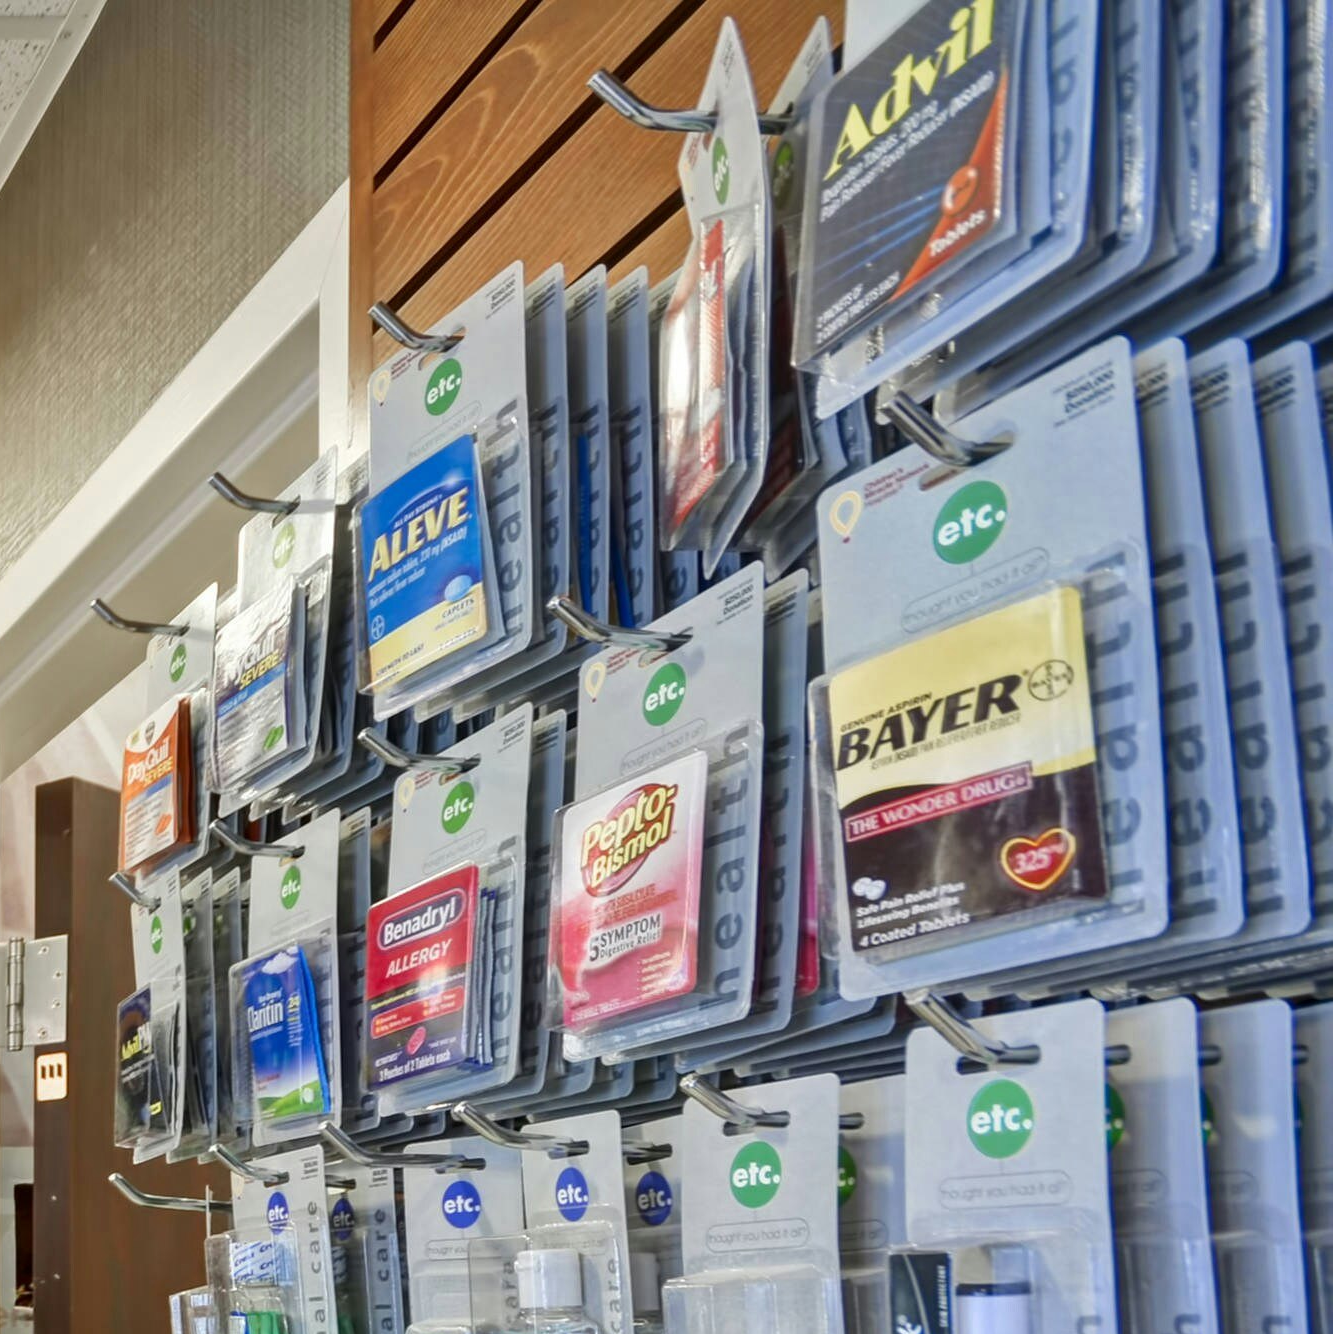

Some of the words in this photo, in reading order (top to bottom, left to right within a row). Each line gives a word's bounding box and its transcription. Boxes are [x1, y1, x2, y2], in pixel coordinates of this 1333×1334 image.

[823, 0, 993, 181] Advil
[930, 210, 986, 258] Tablets
[426, 373, 462, 405] etc.
[368, 487, 469, 583] ALEVE
[937, 504, 1007, 547] etc.
[240, 650, 281, 690] SEVERE
[644, 681, 685, 712] etc.
[887, 691, 932, 715] ASPIRIN
[836, 674, 1022, 771] BAYER
[127, 739, 170, 785] DayQuil
[443, 796, 475, 822] etc.
[580, 785, 677, 867] Pepto-
[850, 815, 879, 836] THE
[883, 792, 958, 825] WONDER
[591, 816, 674, 889] Bismol
[709, 724, 751, 1003] health
[282, 881, 301, 897] etc.
[856, 900, 879, 918] Safe
[880, 895, 902, 911] Pain
[383, 897, 456, 947] Benadryl
[589, 937, 600, 961] 5
[599, 913, 662, 948] SYMPTOM
[859, 934, 869, 948] 4
[871, 922, 917, 945] Coated
[920, 911, 970, 934] Tablets
[385, 937, 454, 979] ALLERGY
[247, 1000, 284, 1034] Claritin
[970, 1104, 1033, 1135] etc.
[557, 1185, 589, 1205] etc.
[732, 1162, 781, 1187] etc.
[268, 1206, 289, 1223] etc.
[443, 1196, 481, 1213] etc.
[637, 1188, 672, 1209] etc.
[308, 1201, 323, 1274] care
[333, 1213, 355, 1228] etc.
[372, 1208, 390, 1283] care
[606, 1259, 624, 1334] care
